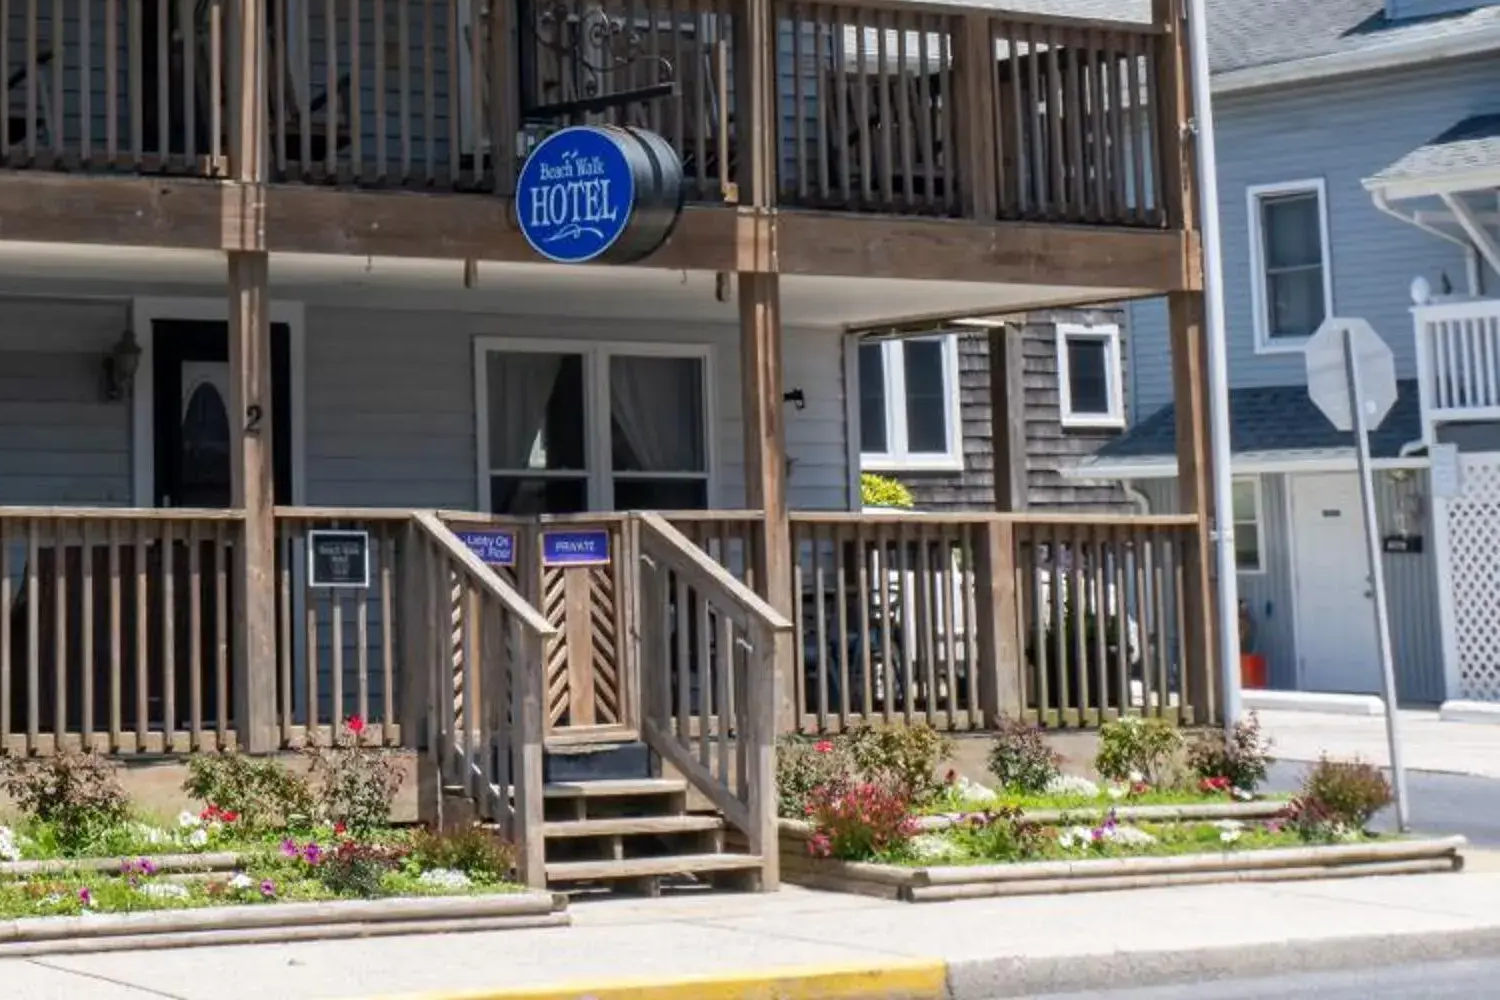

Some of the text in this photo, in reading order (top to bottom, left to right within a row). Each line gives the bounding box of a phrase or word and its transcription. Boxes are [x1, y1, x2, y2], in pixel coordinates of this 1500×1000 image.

[540, 156, 605, 180] Beach Walk
[529, 178, 618, 227] HOTEL
[245, 404, 263, 436] 2
[555, 541, 595, 553] PRIVATE
